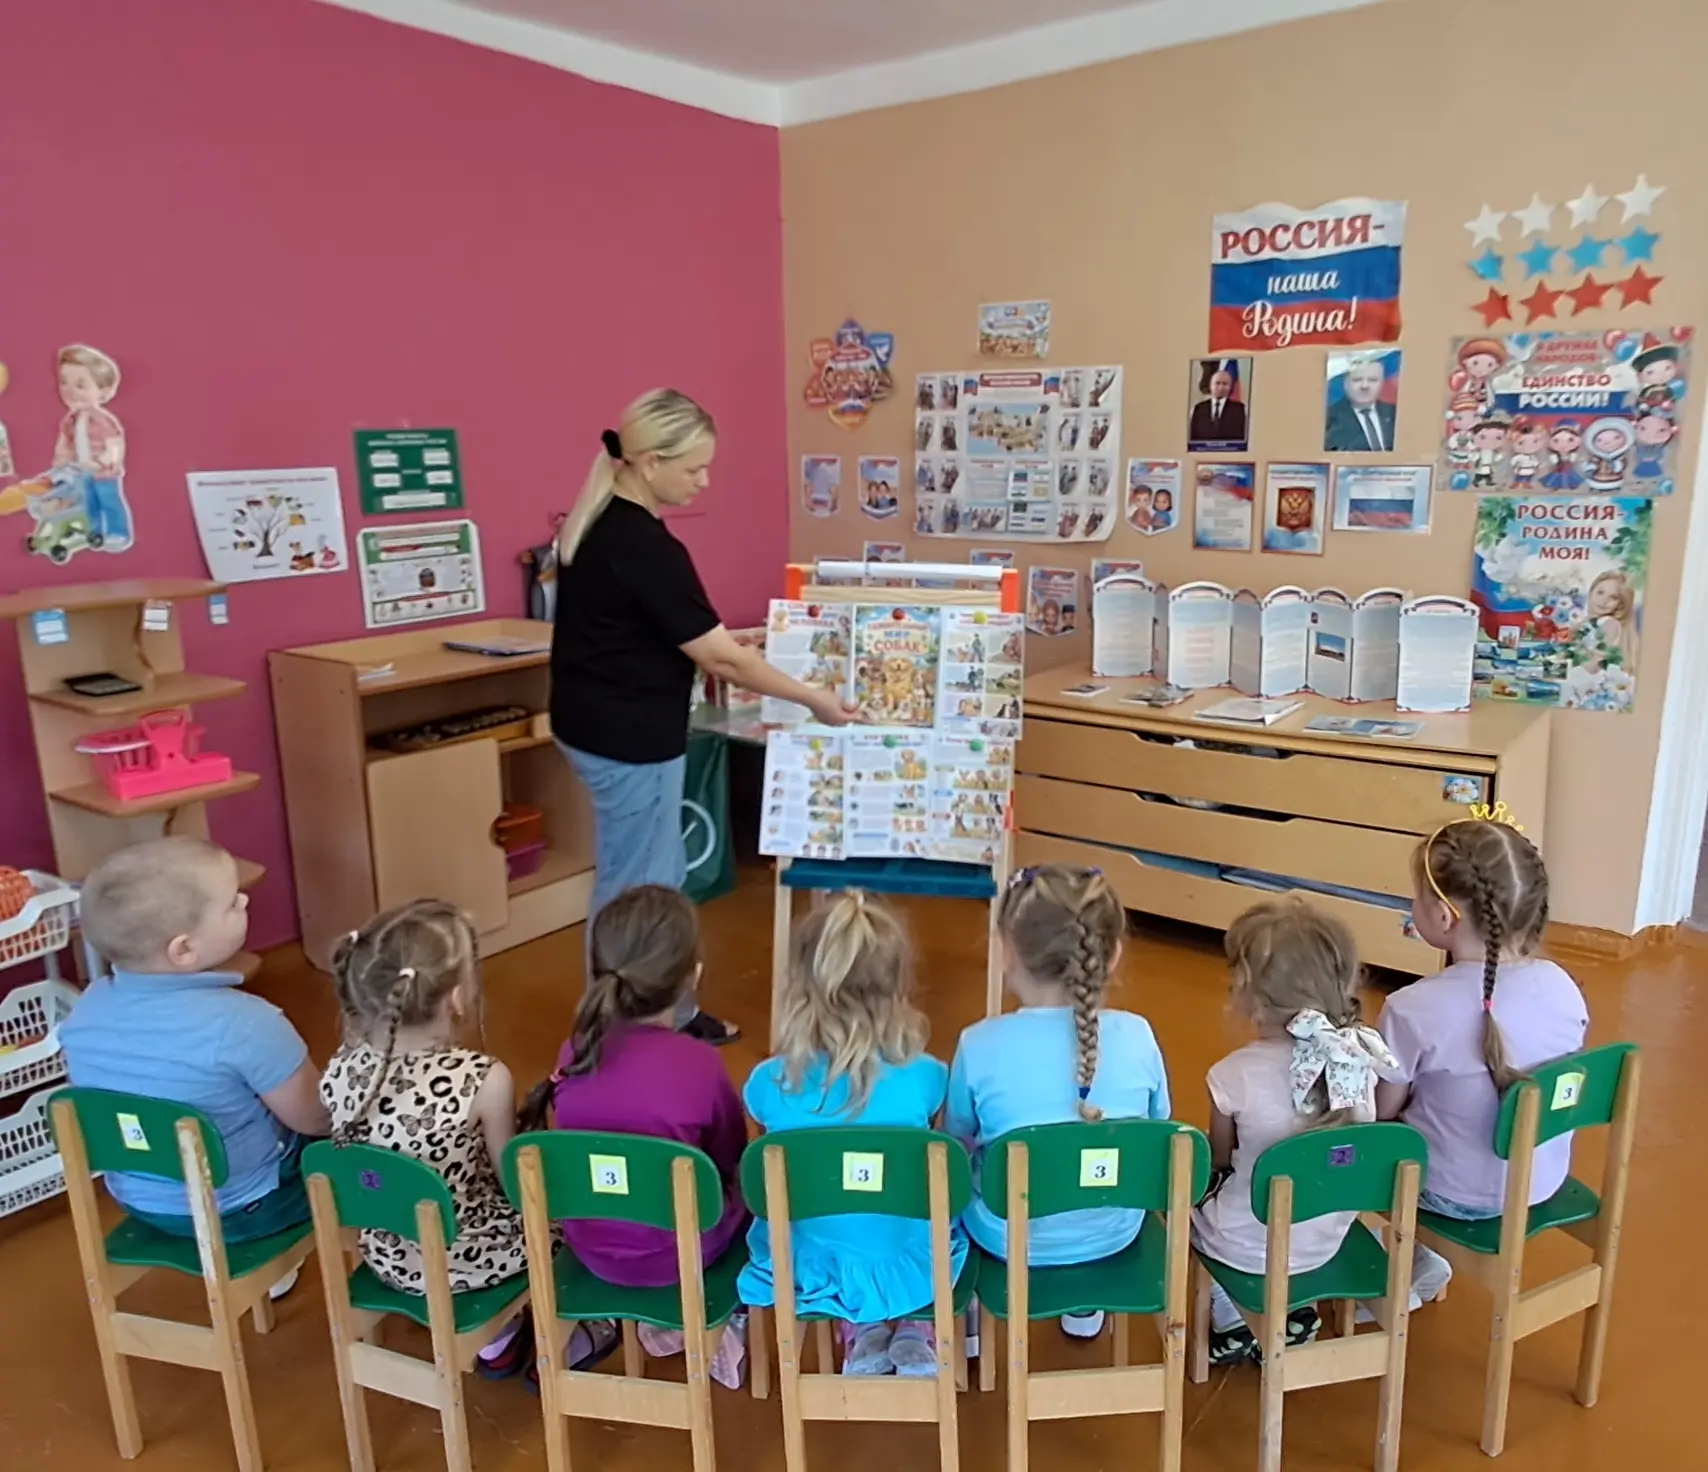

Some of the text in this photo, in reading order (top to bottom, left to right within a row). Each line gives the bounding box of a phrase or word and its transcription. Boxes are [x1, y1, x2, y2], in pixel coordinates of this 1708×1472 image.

[1220, 214, 1385, 259] РОССИЯ-
[1266, 269, 1340, 295] наша
[1242, 296, 1358, 347] Родина!
[1521, 374, 1612, 389] ЕДИНСТВО
[1519, 391, 1611, 408] РОССИИ!
[1517, 504, 1625, 520] РОССИЯ-
[1522, 526, 1608, 541] РОДИНА
[1539, 546, 1590, 560] МОЯ!
[1563, 1087, 1573, 1100] 3
[132, 1128, 143, 1141] 3
[1336, 1150, 1346, 1164] 2
[606, 1171, 617, 1185] 3
[857, 1168, 870, 1182] 3
[1094, 1165, 1106, 1178] 3
